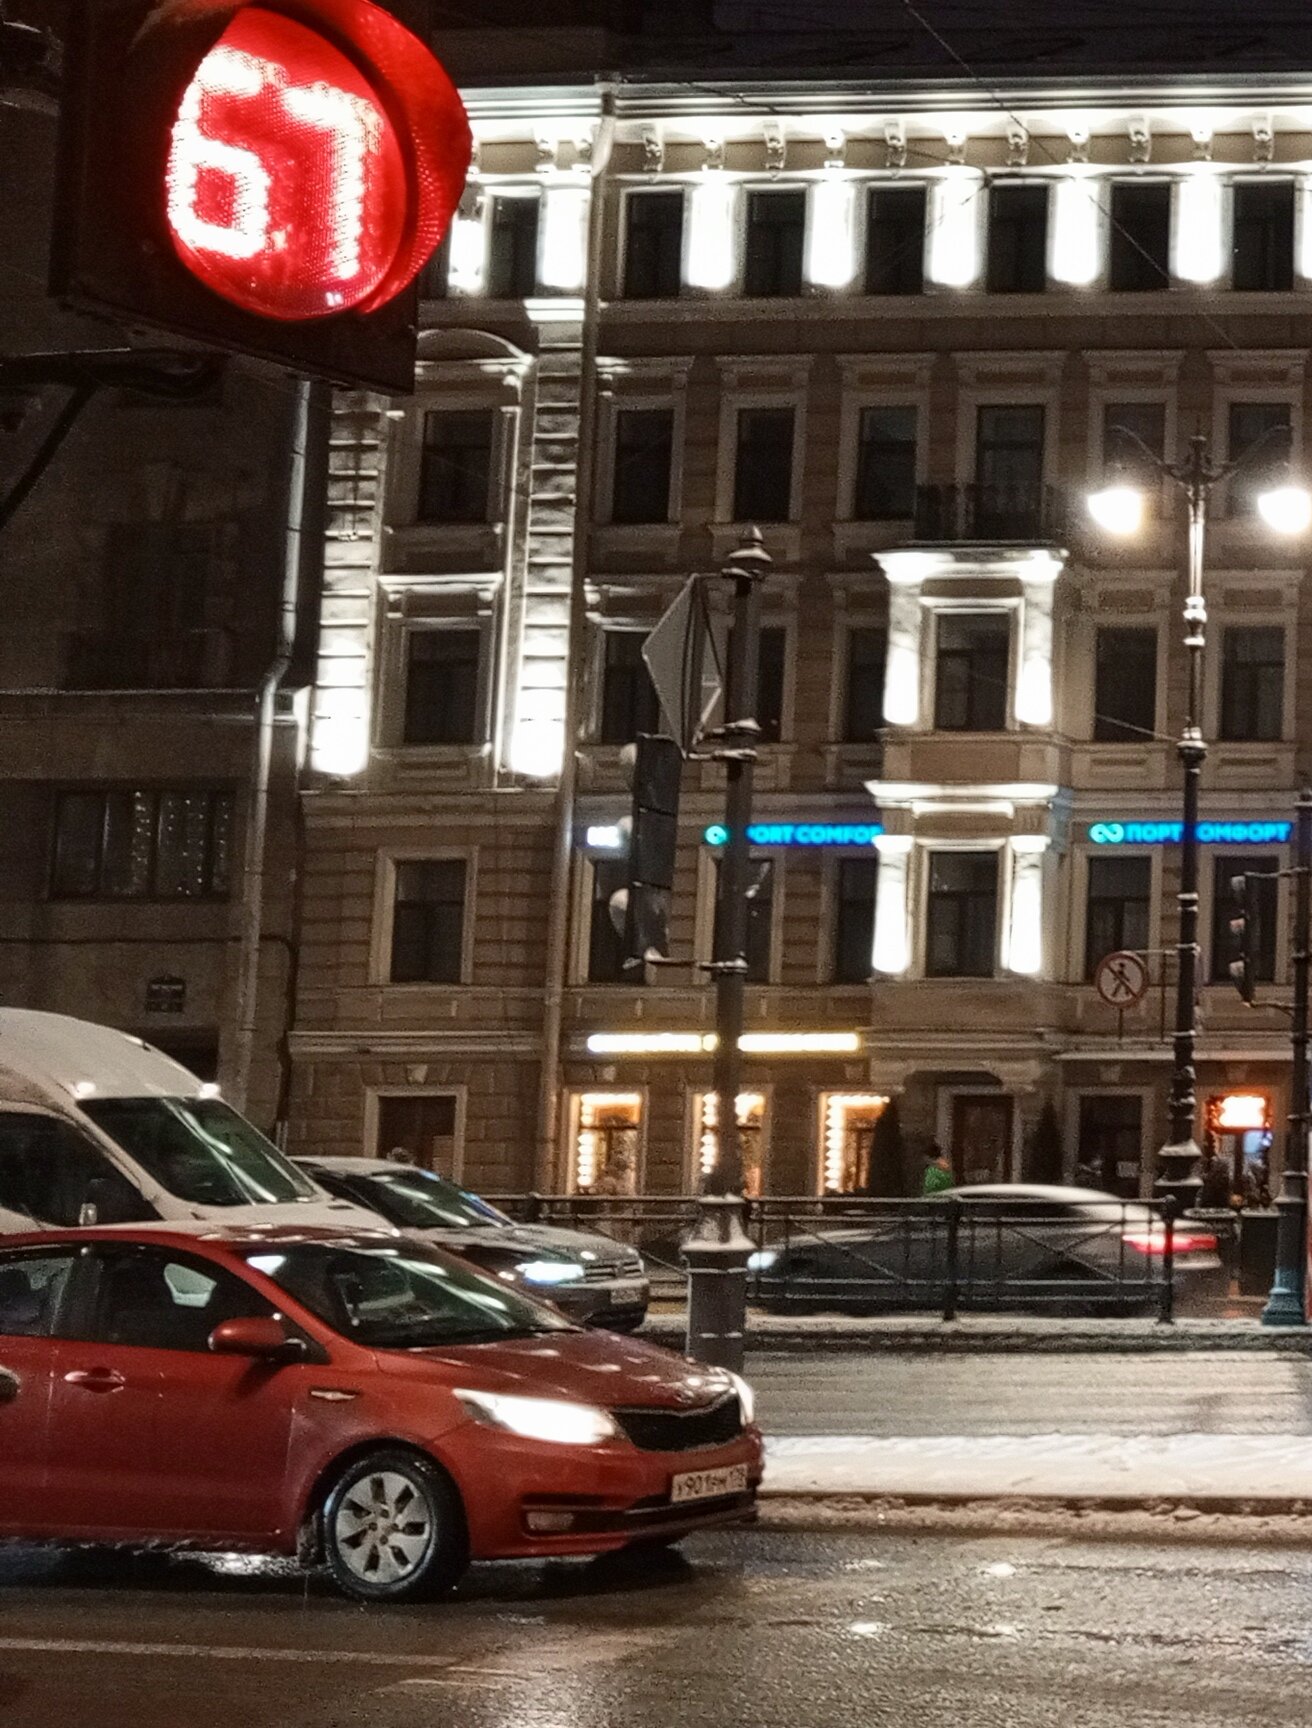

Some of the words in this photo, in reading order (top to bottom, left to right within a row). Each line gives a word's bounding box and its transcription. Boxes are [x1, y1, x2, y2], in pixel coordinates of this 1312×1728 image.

[167, 46, 382, 280] 67
[1126, 823, 1184, 843] ПОРТ
[1196, 823, 1292, 843] ОМФОРТ
